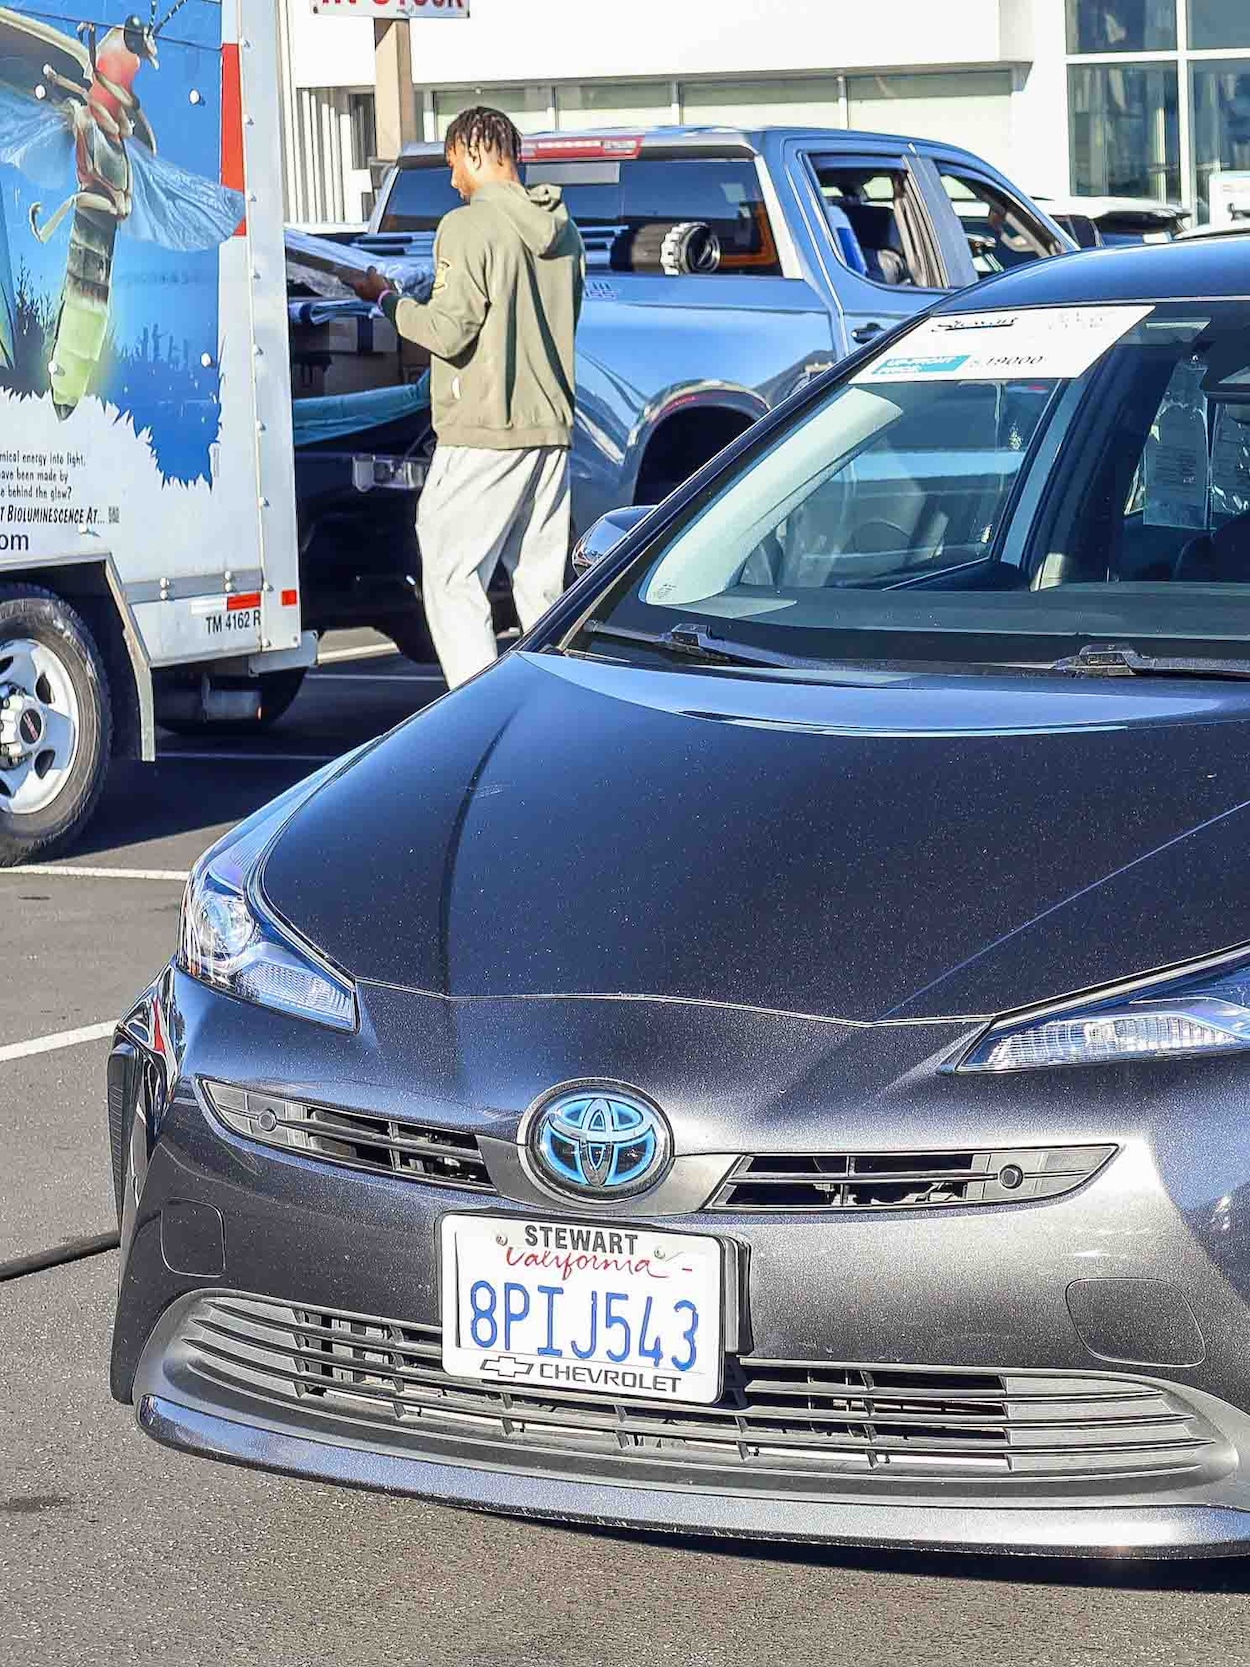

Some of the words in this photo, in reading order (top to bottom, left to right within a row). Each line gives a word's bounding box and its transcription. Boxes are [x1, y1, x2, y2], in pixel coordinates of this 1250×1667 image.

[22, 453, 47, 467] energy
[49, 450, 64, 465] into
[16, 466, 35, 481] been
[37, 468, 57, 481] made
[59, 469, 69, 484] by
[8, 484, 33, 498] behind
[36, 484, 48, 498] the
[50, 485, 72, 502] glow?
[205, 614, 223, 635] TM
[225, 611, 250, 631] 4162
[253, 609, 262, 626] R
[525, 1224, 639, 1255] STEWART
[505, 1246, 670, 1281] California
[470, 1280, 700, 1372] 8PIJ543
[539, 1363, 682, 1394] CHEVROLET
